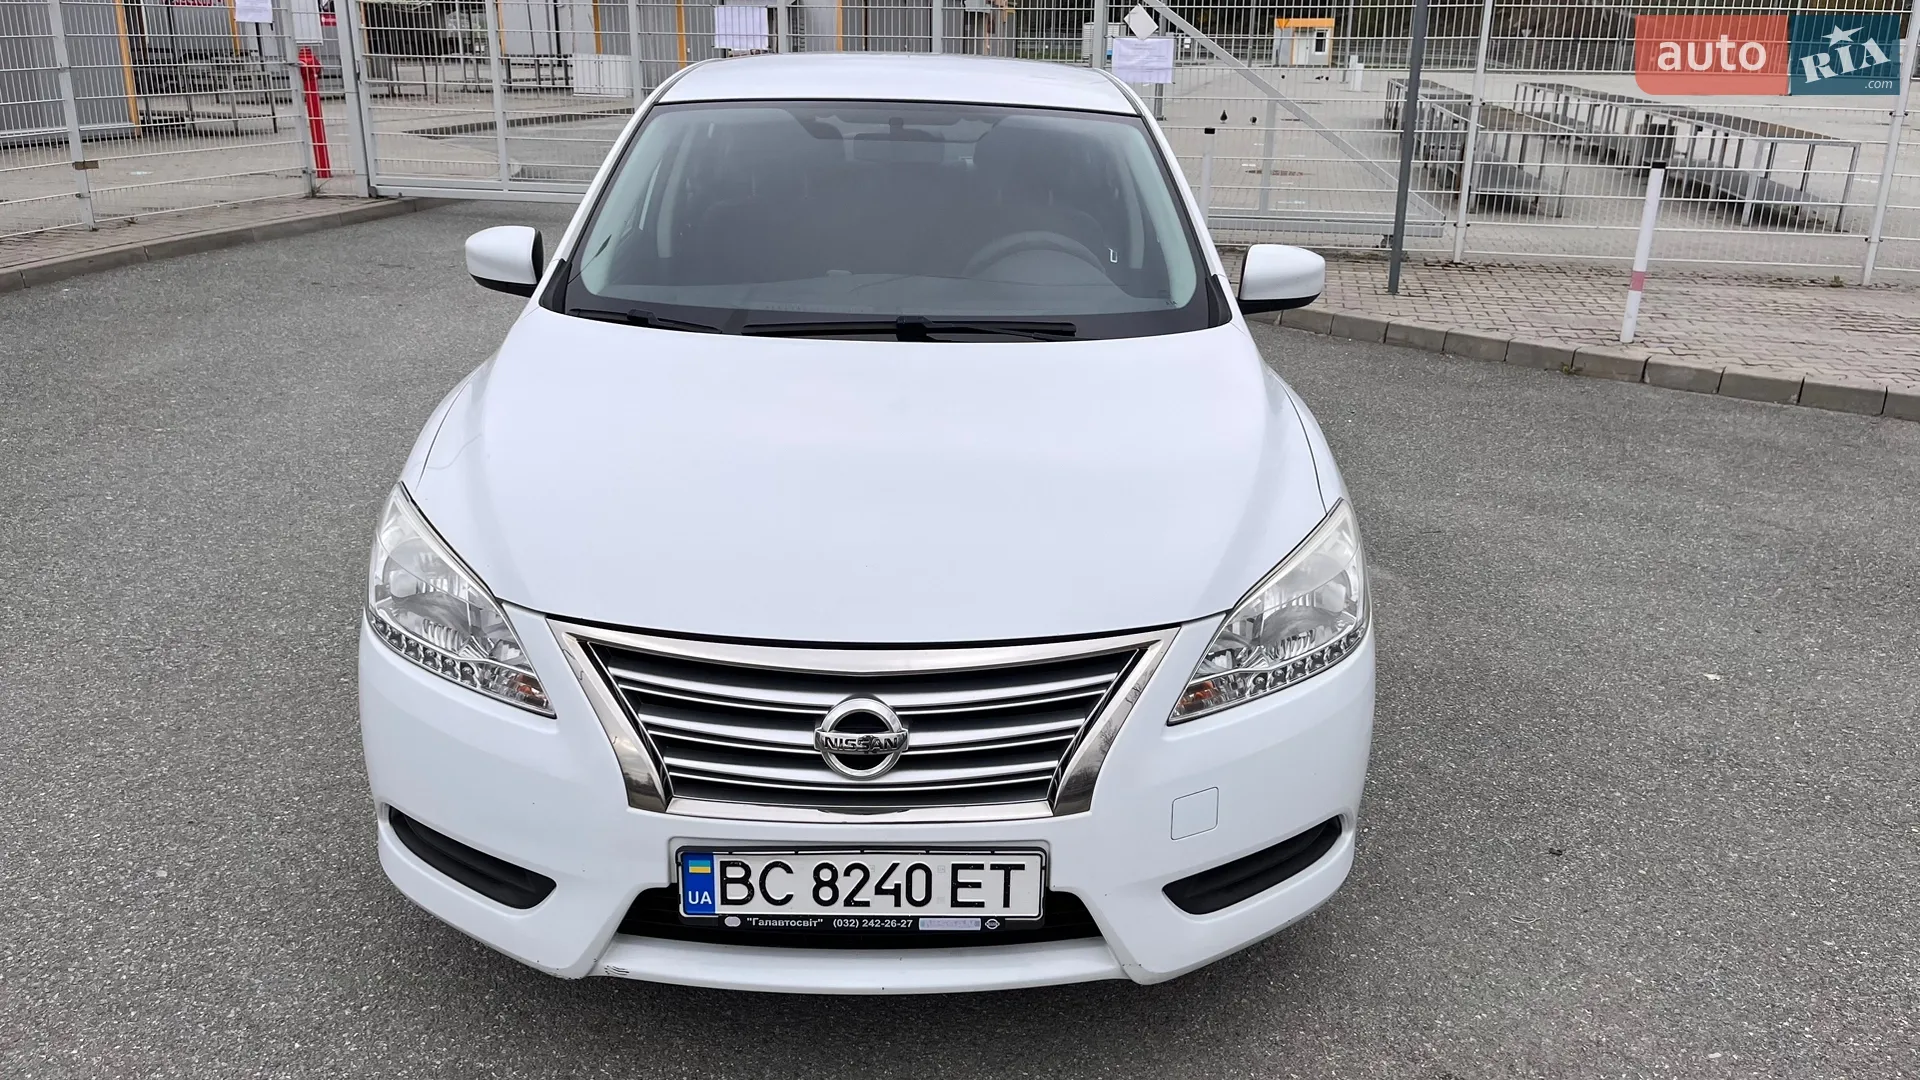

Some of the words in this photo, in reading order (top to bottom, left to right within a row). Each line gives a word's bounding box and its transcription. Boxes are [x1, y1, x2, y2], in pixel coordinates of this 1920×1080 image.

[824, 736, 898, 752] NISSAN
[719, 860, 794, 906] BC
[811, 862, 932, 908] 8240
[950, 863, 1026, 908] ET
[688, 891, 712, 904] UA
[746, 917, 824, 928] "Галавтосвіт"
[832, 918, 860, 929] (032)
[862, 919, 913, 929] 242-26-27
